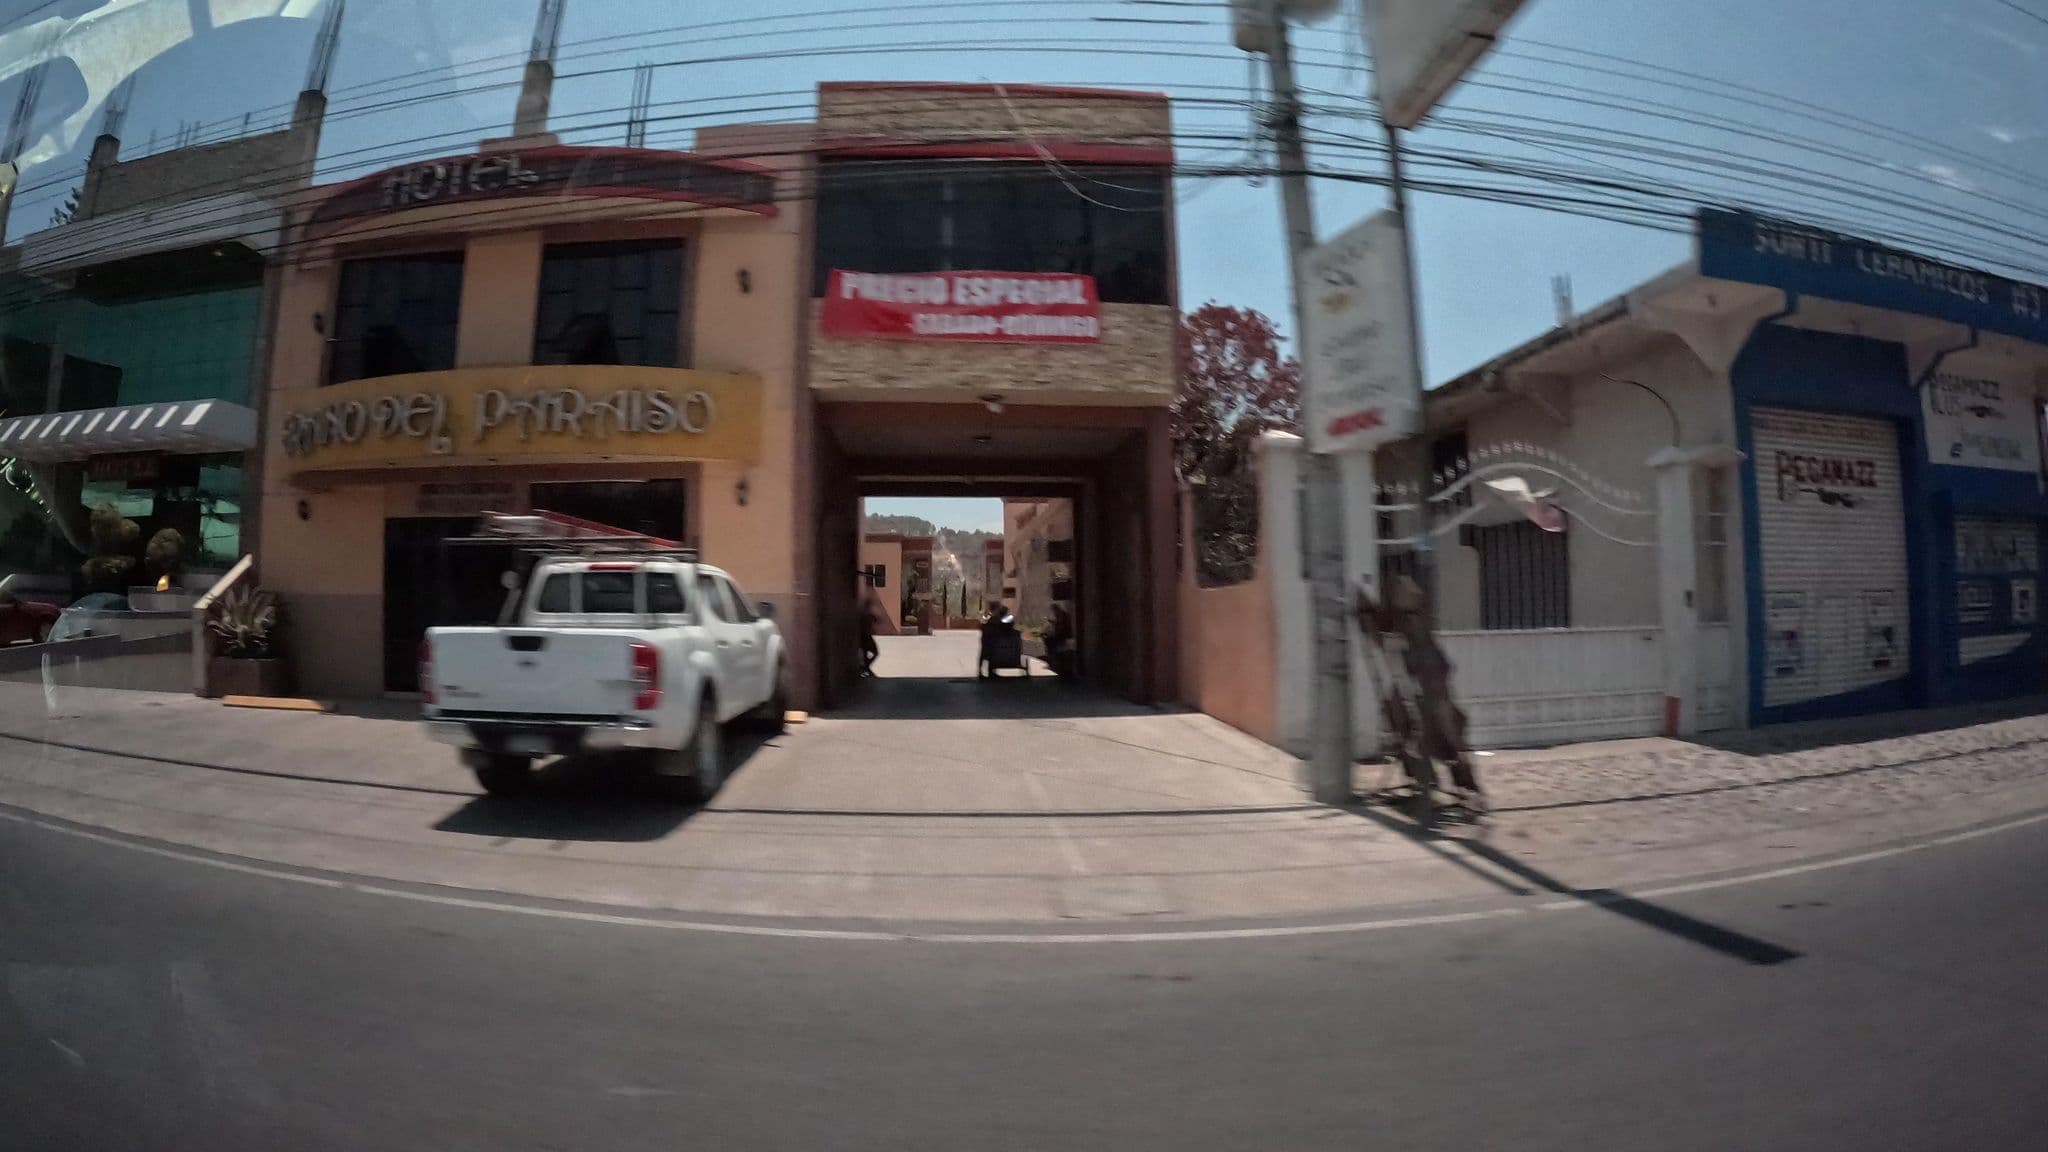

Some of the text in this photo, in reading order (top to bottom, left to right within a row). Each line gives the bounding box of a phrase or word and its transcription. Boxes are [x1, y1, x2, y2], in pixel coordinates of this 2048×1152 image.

[383, 154, 540, 208] HOTEL
[840, 271, 1087, 307] PRECIO ESPECIAL
[474, 387, 716, 445] PARAISO
